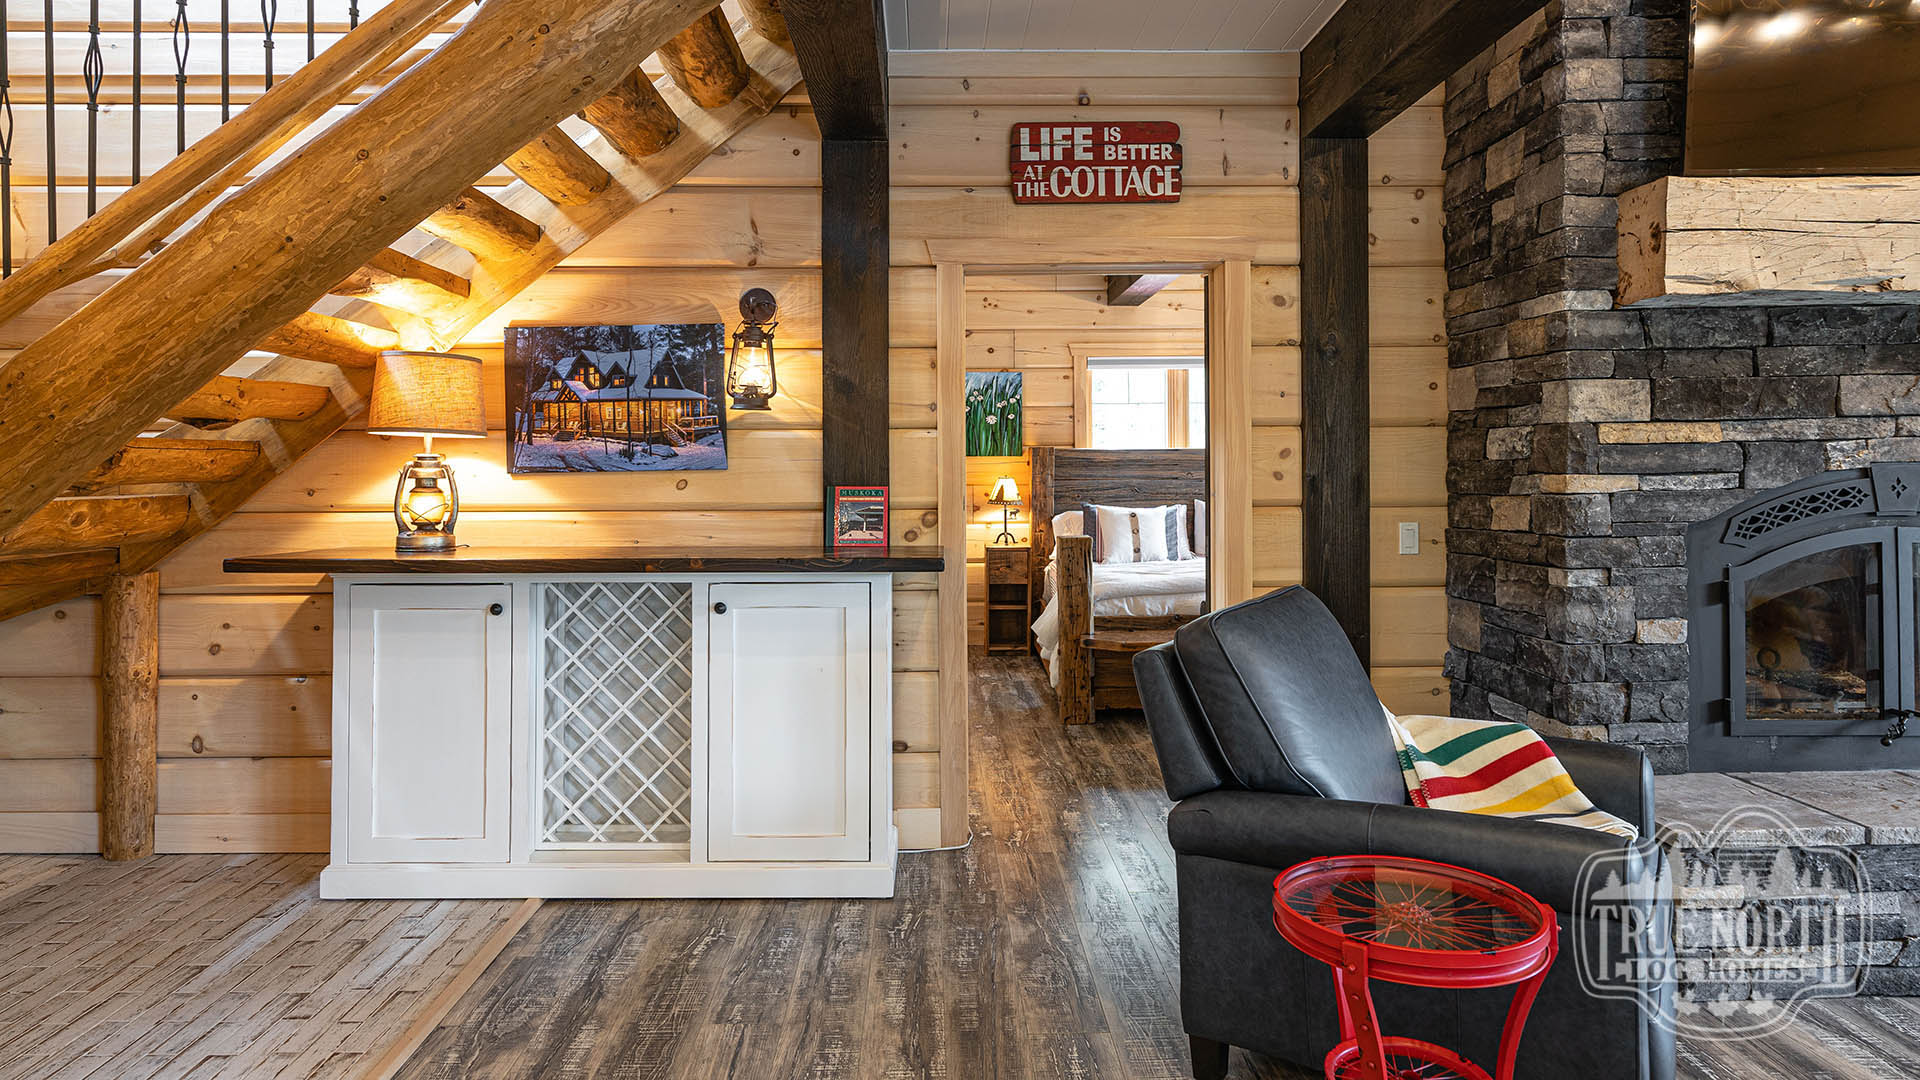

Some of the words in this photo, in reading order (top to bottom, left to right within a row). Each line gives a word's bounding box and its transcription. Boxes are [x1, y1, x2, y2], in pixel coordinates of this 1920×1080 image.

[1019, 127, 1093, 161] LIFE
[1103, 126, 1121, 142] IS
[1104, 144, 1173, 160] BETTER
[1014, 181, 1050, 197] THE
[1050, 165, 1180, 197] COTTAGE
[1023, 164, 1047, 180] AT
